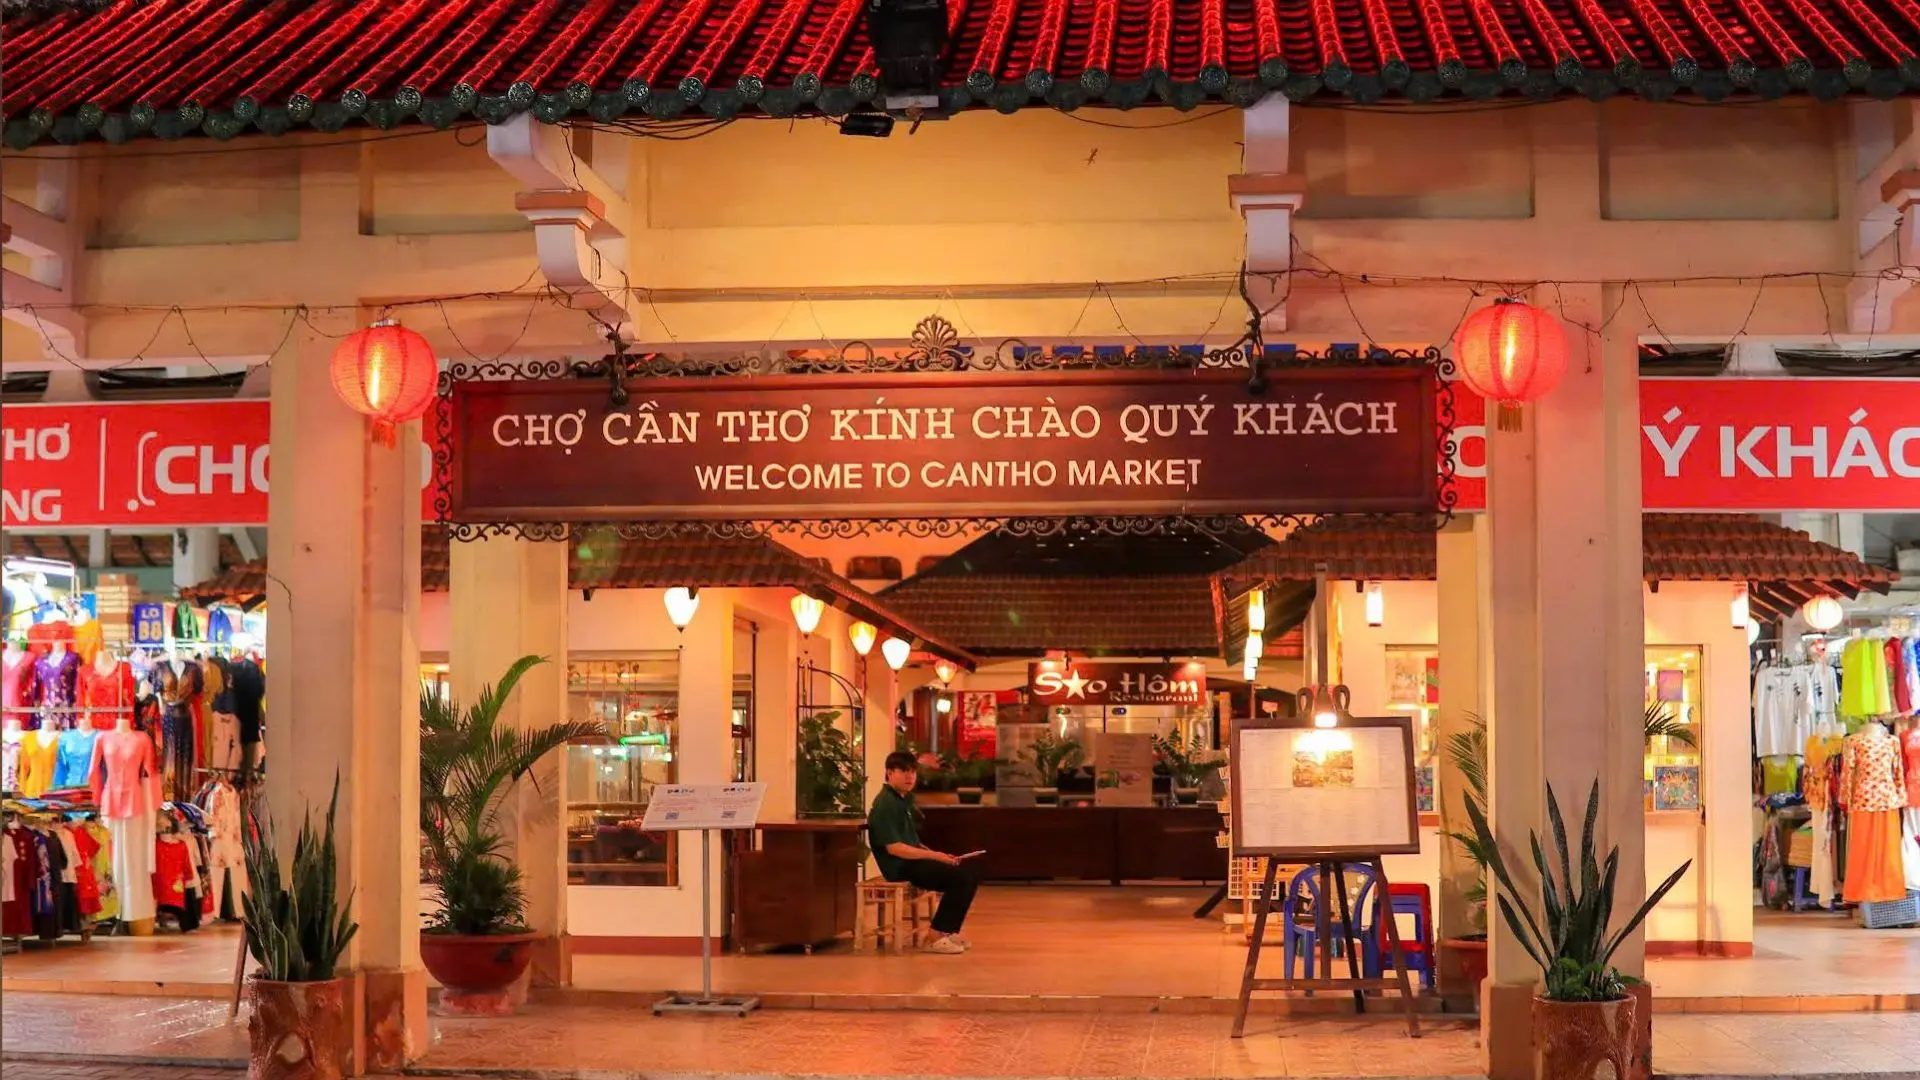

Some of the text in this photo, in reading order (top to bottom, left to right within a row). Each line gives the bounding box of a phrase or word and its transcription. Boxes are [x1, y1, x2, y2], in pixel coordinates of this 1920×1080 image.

[2, 422, 71, 461] HƠ
[492, 392, 1398, 455] CHỢ CẦN THƠ KÍNH CHÀO QUÝ KHÁCH
[694, 458, 1202, 491] WELCOME TO CANTHO MARKET
